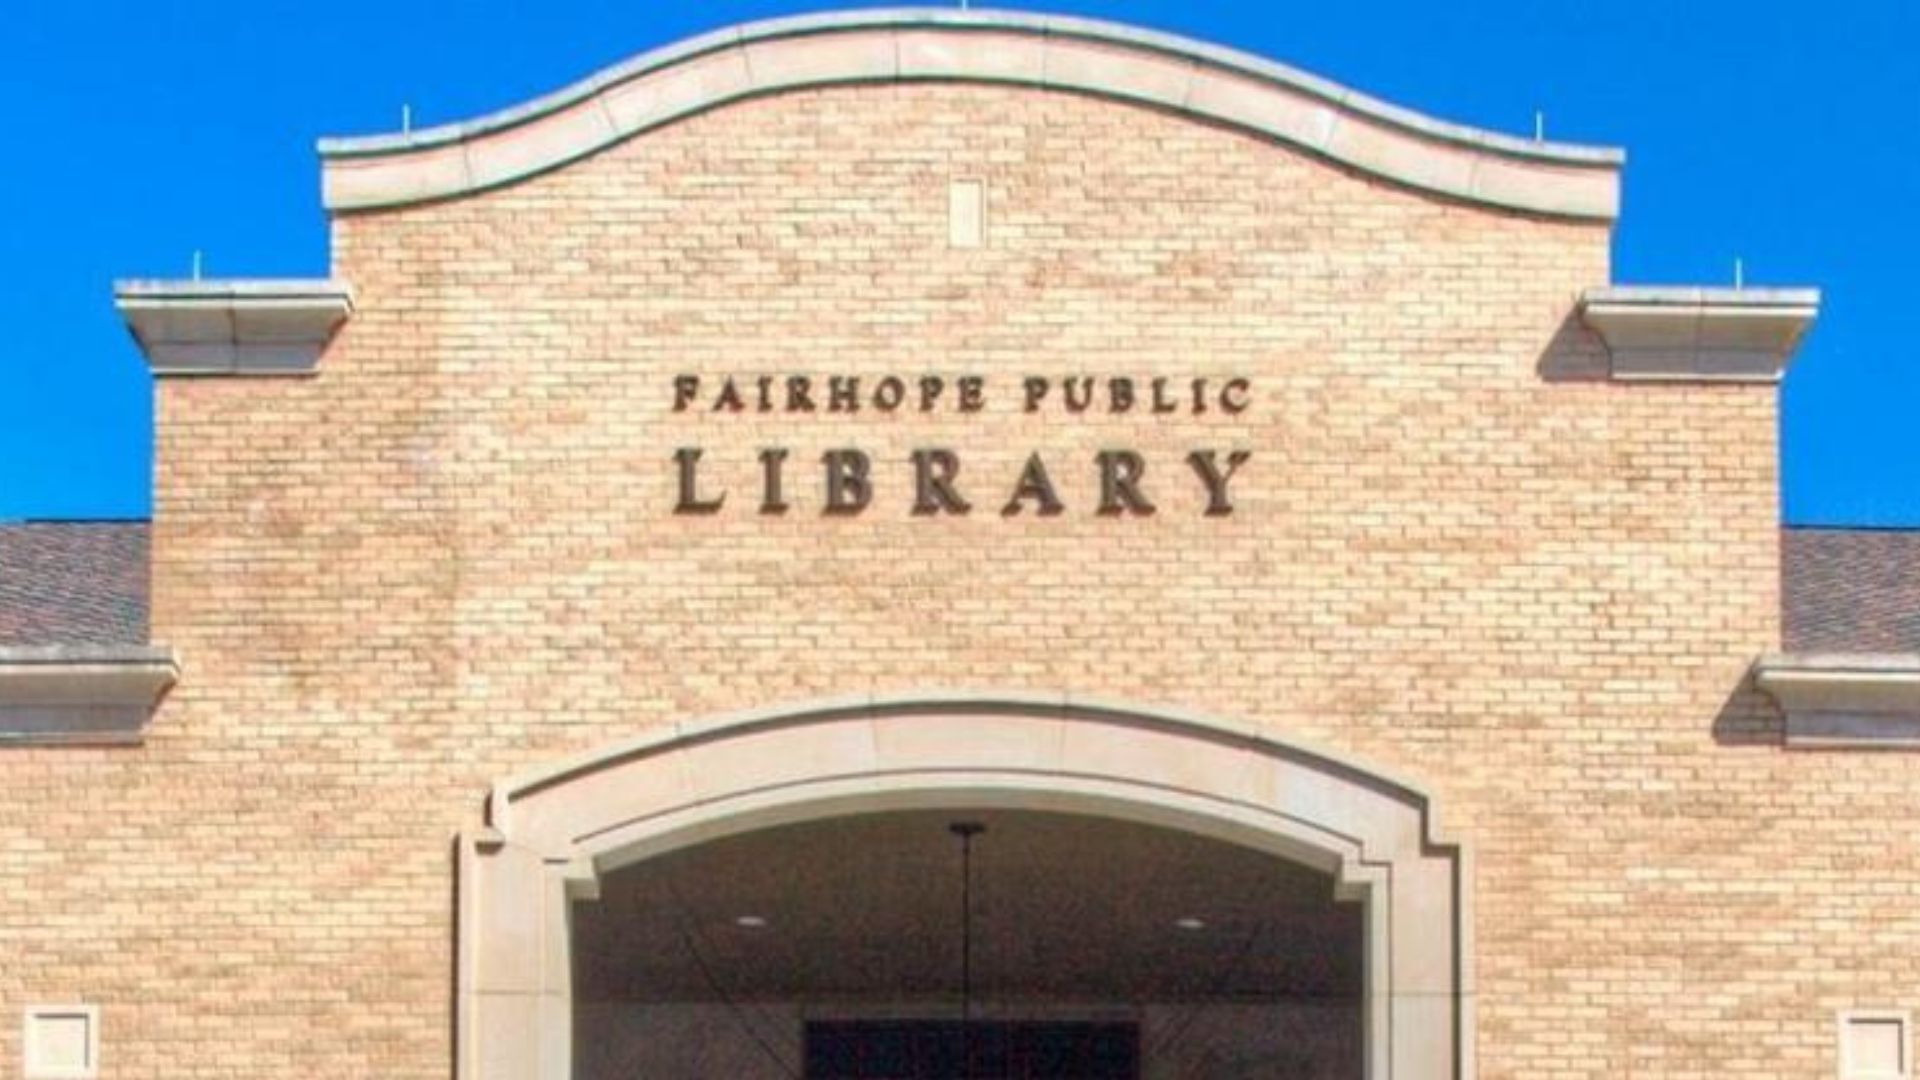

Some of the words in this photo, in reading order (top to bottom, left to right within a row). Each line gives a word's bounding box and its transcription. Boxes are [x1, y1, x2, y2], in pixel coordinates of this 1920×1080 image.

[672, 374, 985, 413] FAIRHOPE
[1022, 376, 1251, 414] PUBLIC
[672, 447, 1251, 517] LIBRARY
